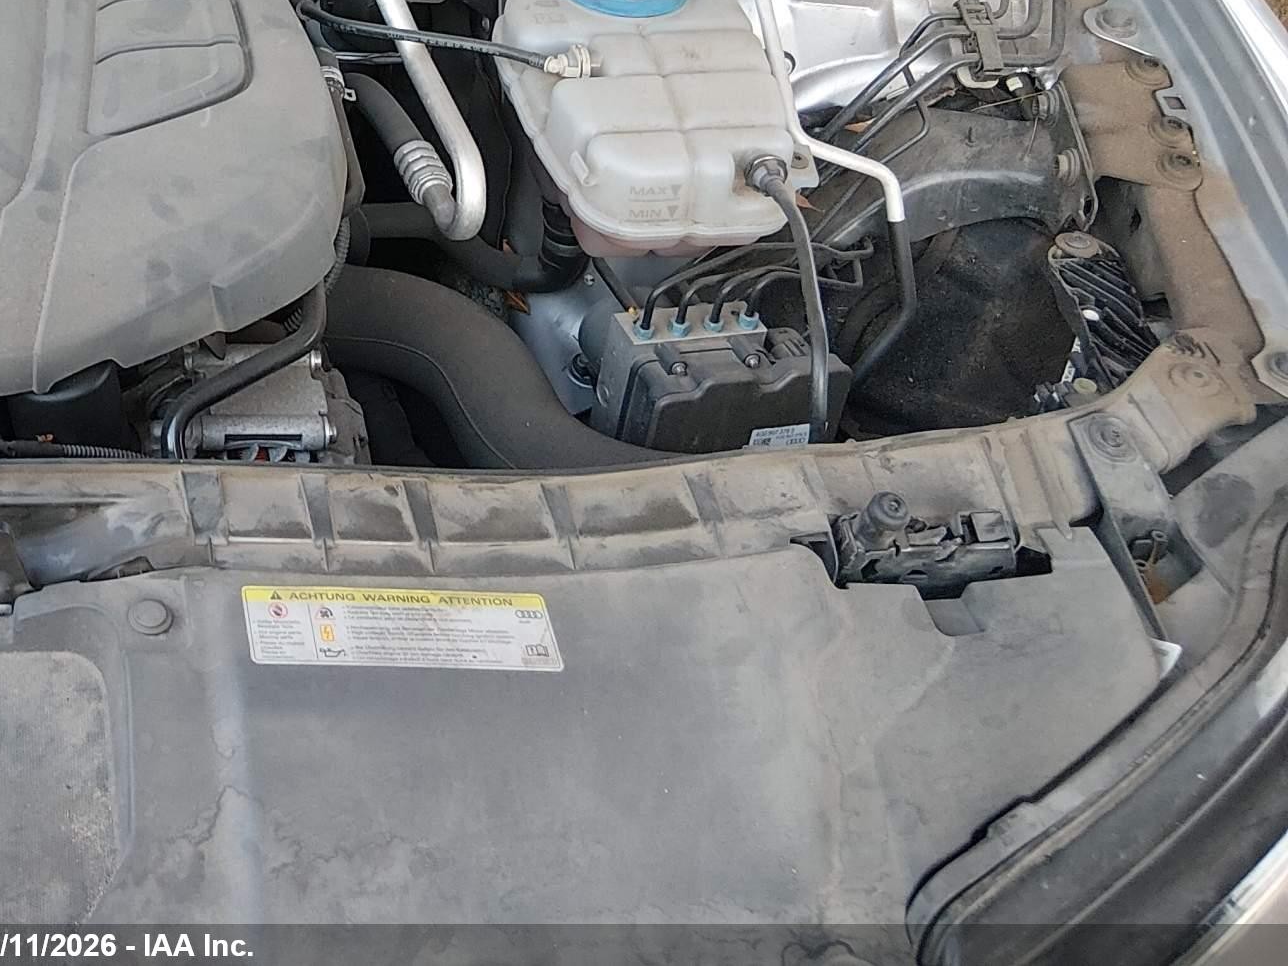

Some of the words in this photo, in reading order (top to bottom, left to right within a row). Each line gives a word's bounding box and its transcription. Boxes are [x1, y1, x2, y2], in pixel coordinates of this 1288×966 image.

[629, 185, 668, 196] MAX
[628, 209, 662, 219] MIN
[289, 591, 356, 602] ACHTUNG
[362, 593, 431, 604] WARNING
[438, 595, 513, 606] ATTENTION
